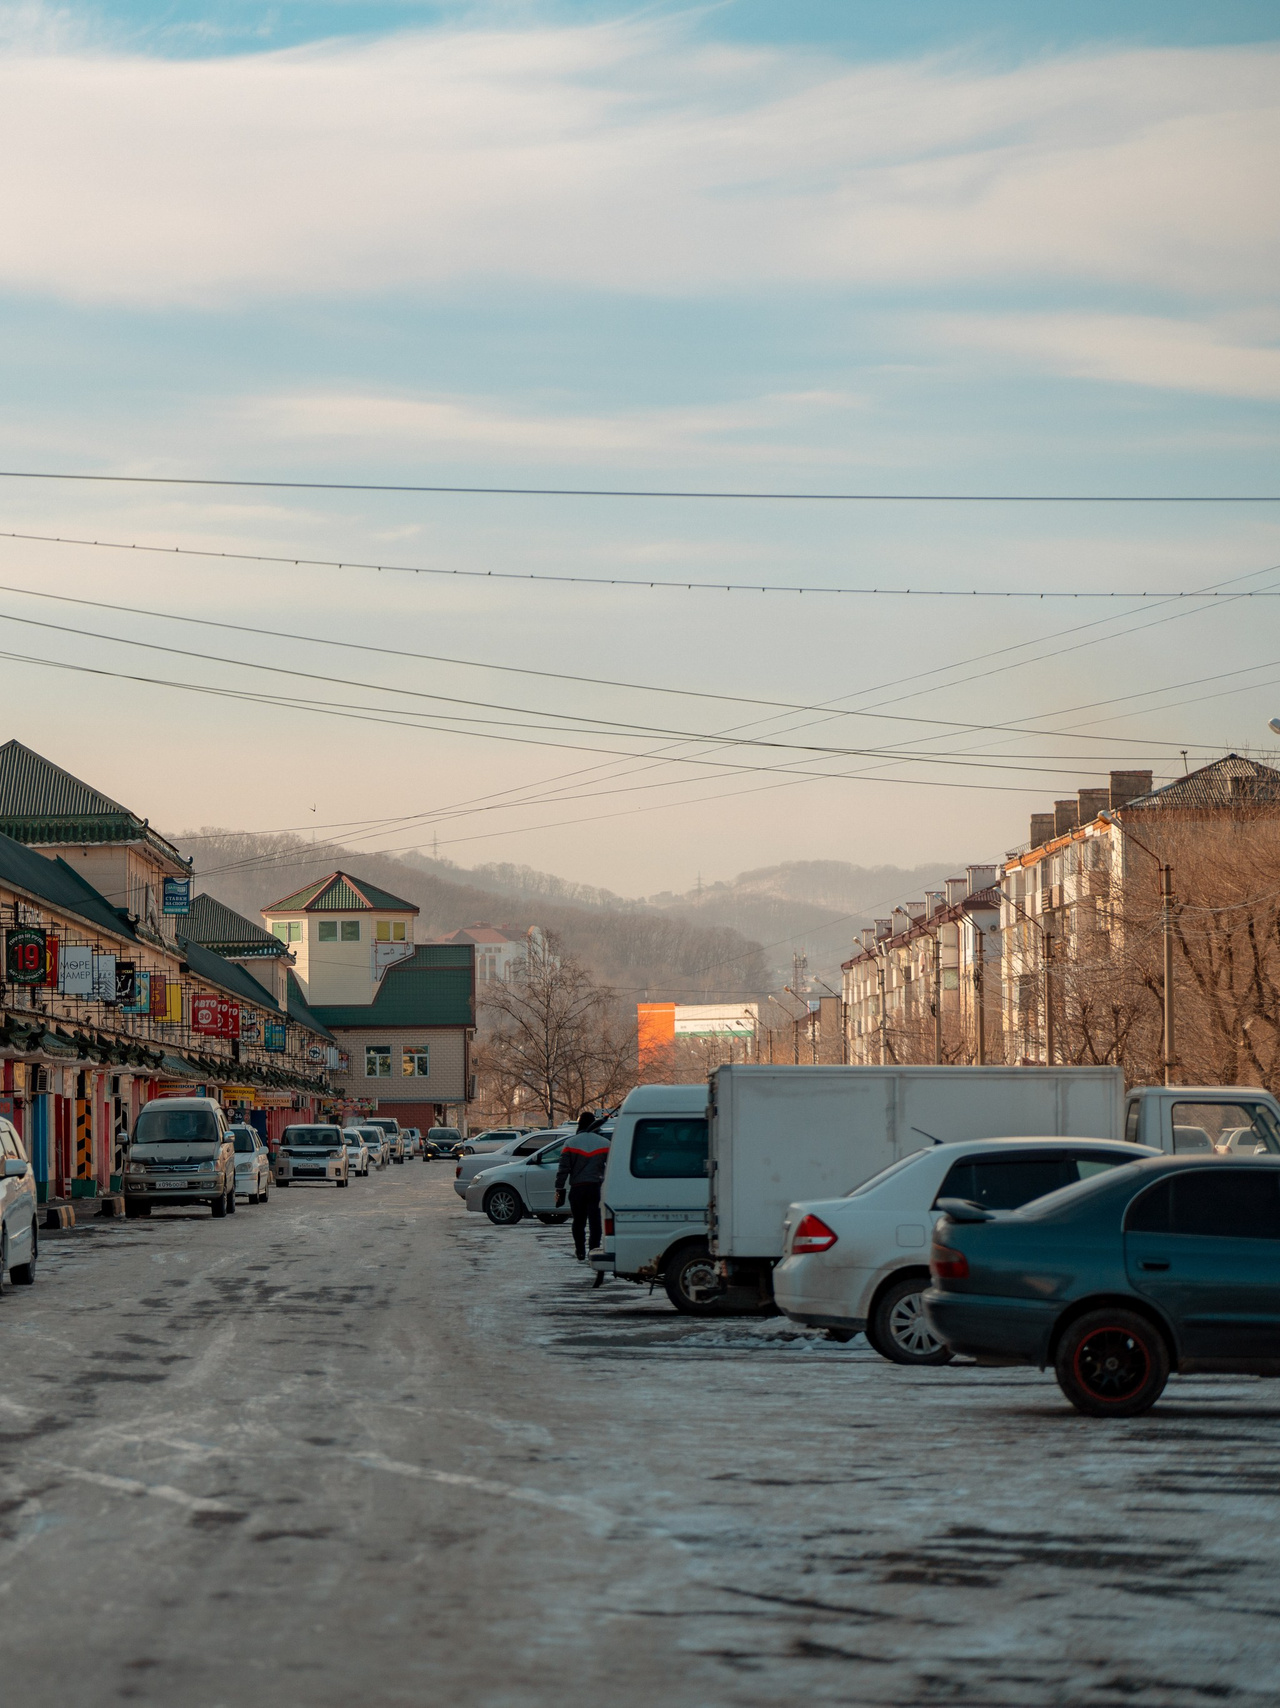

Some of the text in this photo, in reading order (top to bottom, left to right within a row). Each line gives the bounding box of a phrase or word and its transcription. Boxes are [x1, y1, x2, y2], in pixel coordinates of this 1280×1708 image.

[14, 943, 39, 970] 19
[60, 971, 91, 980] КАМЕР
[194, 999, 217, 1008] АВТО
